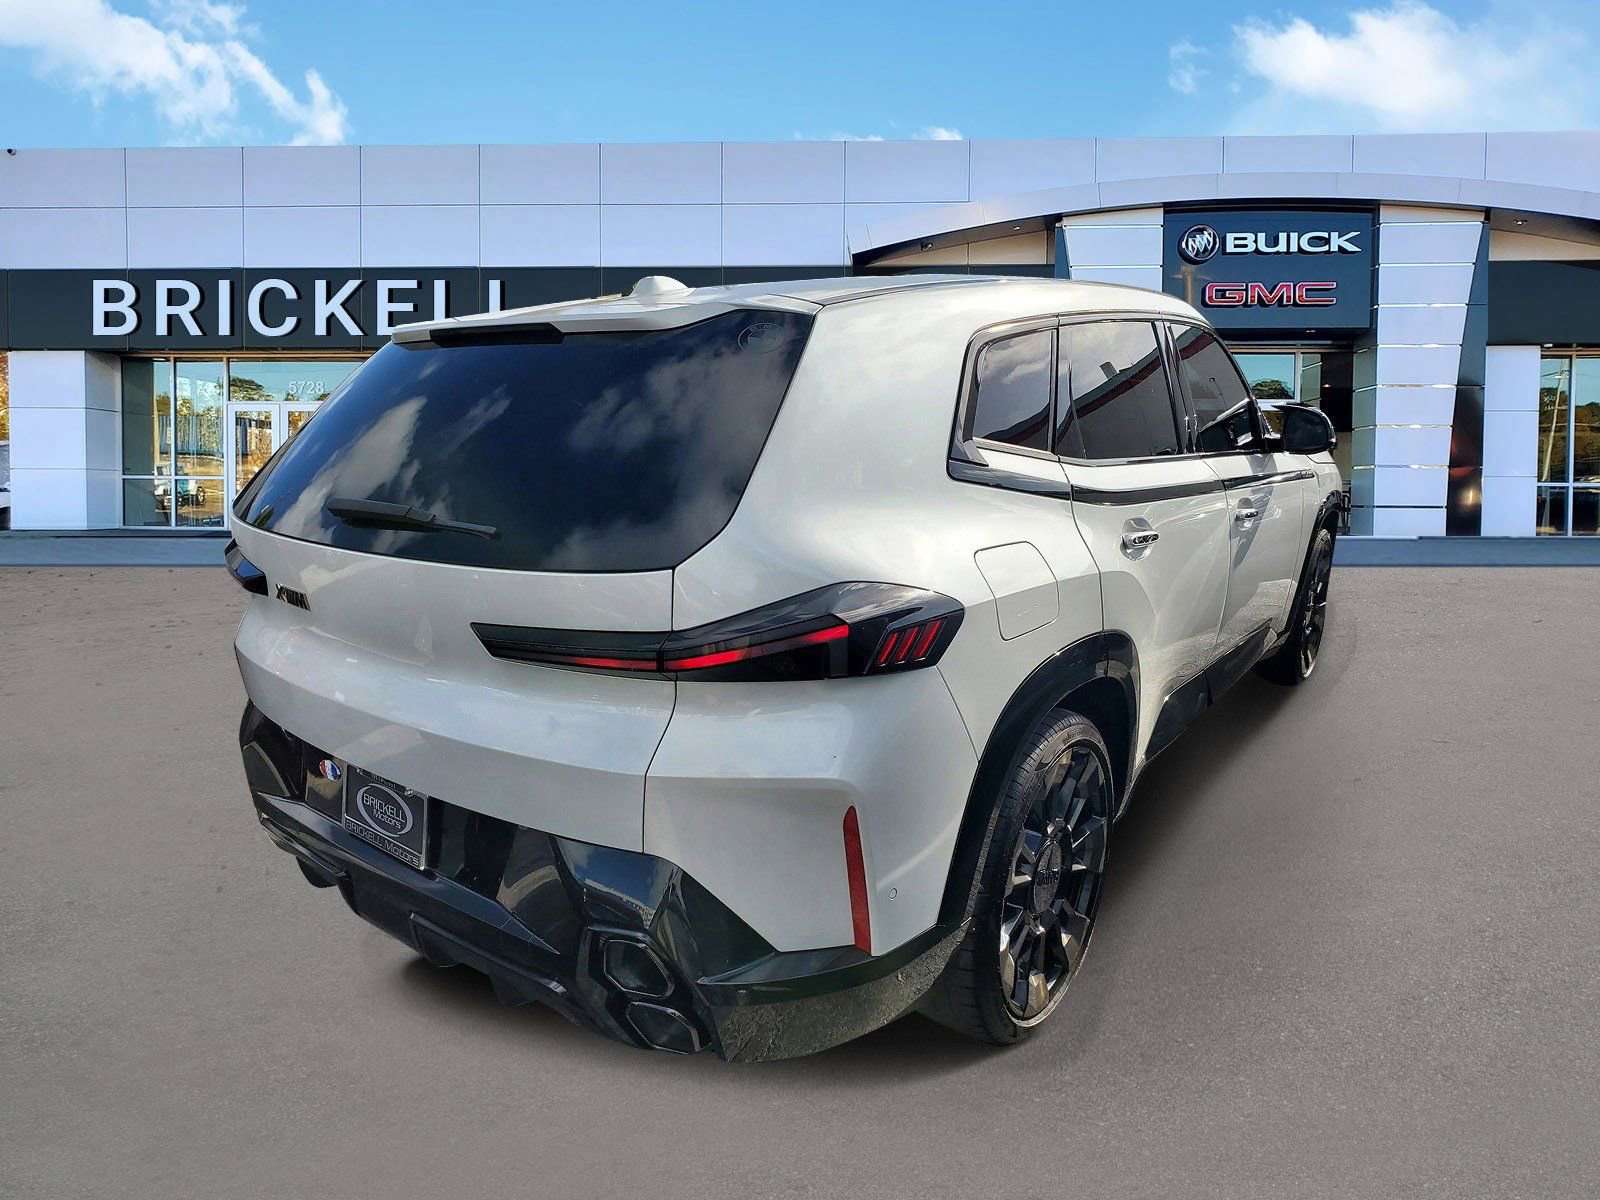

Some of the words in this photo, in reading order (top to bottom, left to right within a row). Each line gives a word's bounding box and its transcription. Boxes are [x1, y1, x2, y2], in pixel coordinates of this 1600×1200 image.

[1226, 231, 1362, 253] BUICK
[1206, 281, 1337, 305] GMC
[288, 381, 325, 394] 5728
[363, 793, 406, 823] BRICKELL
[373, 808, 401, 829] Motors
[345, 819, 383, 847] BRICKELL
[384, 840, 419, 866] Motors
